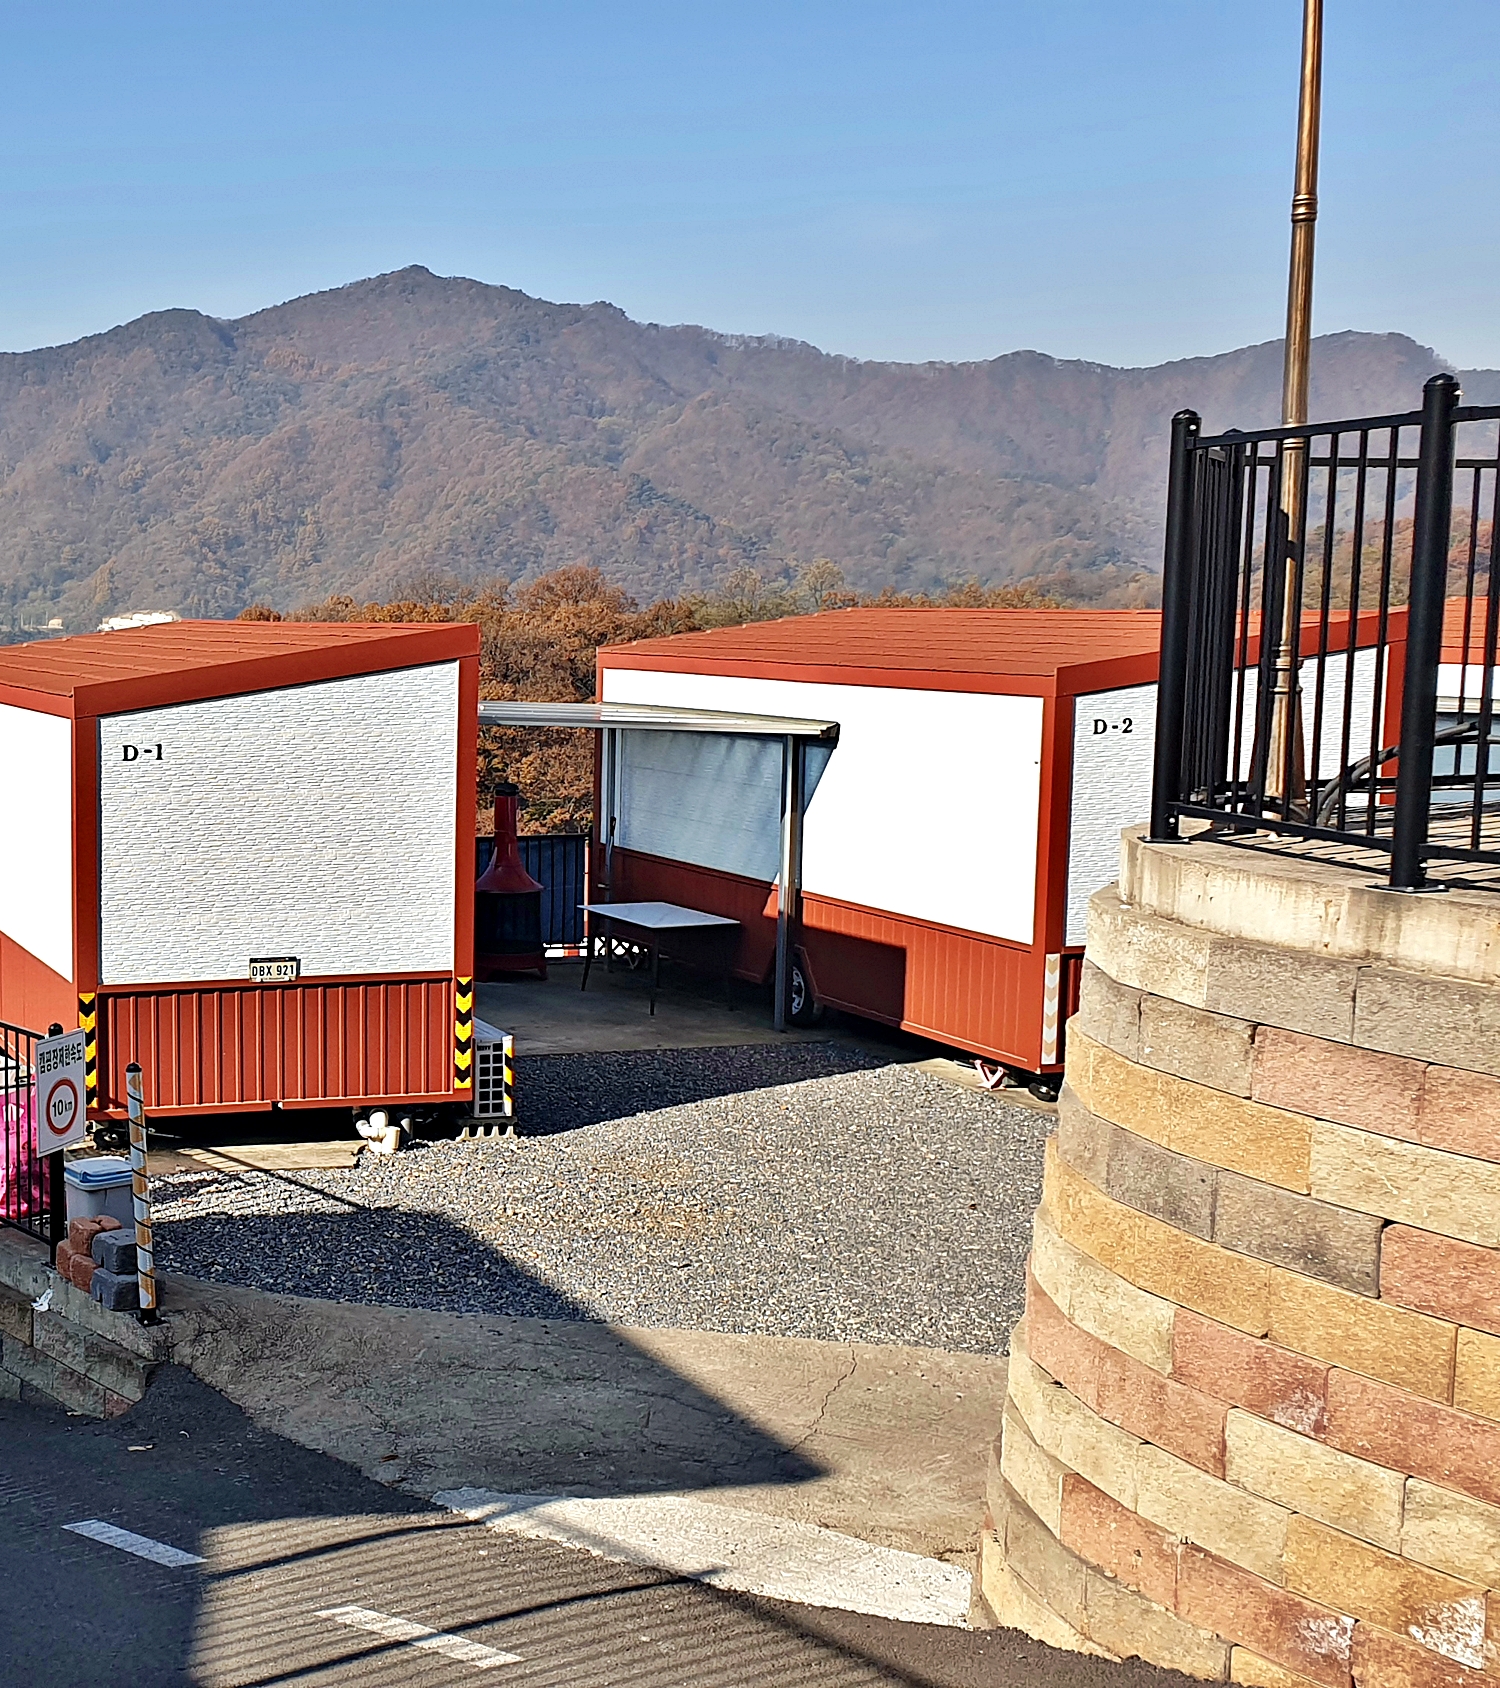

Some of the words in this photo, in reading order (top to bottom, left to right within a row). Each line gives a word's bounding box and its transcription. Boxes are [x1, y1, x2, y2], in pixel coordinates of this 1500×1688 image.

[1092, 717, 1133, 735] D-2
[121, 743, 164, 762] D-1
[251, 965, 273, 977] DBX
[276, 964, 294, 976] 921
